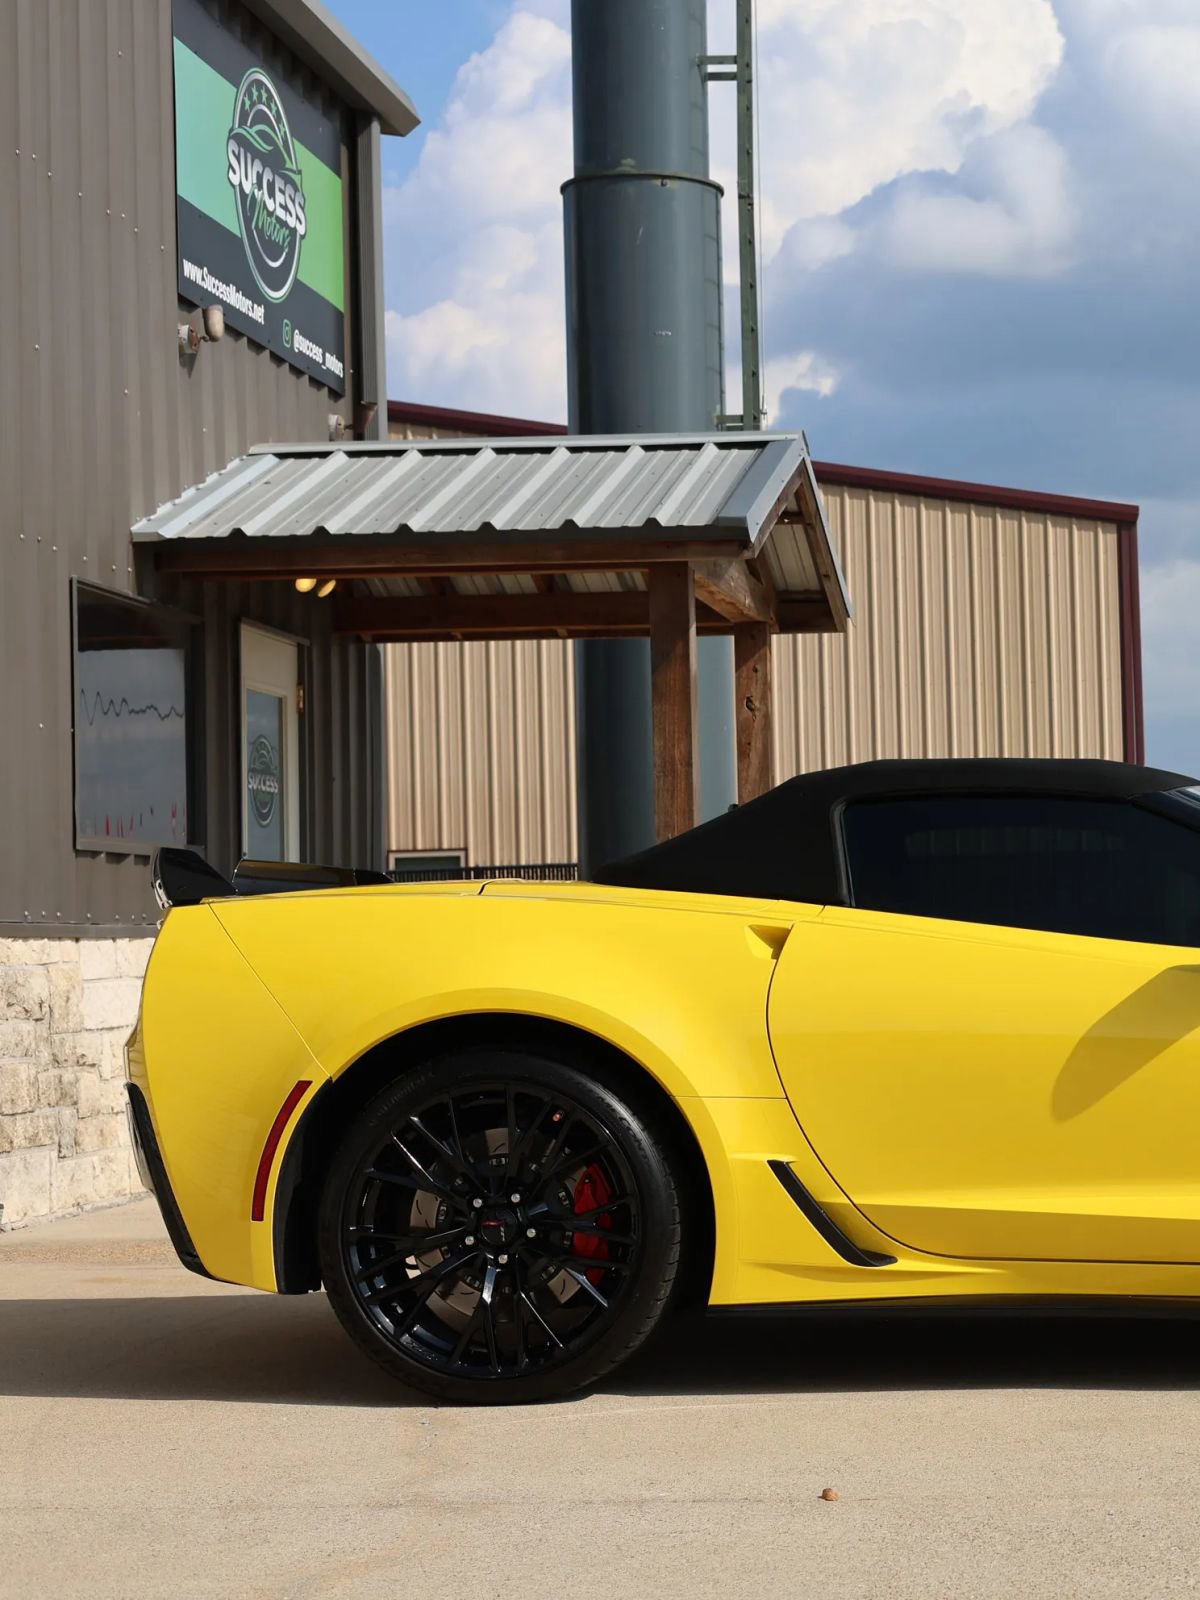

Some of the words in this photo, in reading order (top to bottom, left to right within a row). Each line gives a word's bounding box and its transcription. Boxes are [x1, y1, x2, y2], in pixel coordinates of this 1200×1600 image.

[227, 138, 306, 236] SUCCESS
[182, 258, 265, 325] www.SuccessMotors.net
[293, 329, 344, 378] @success_motors
